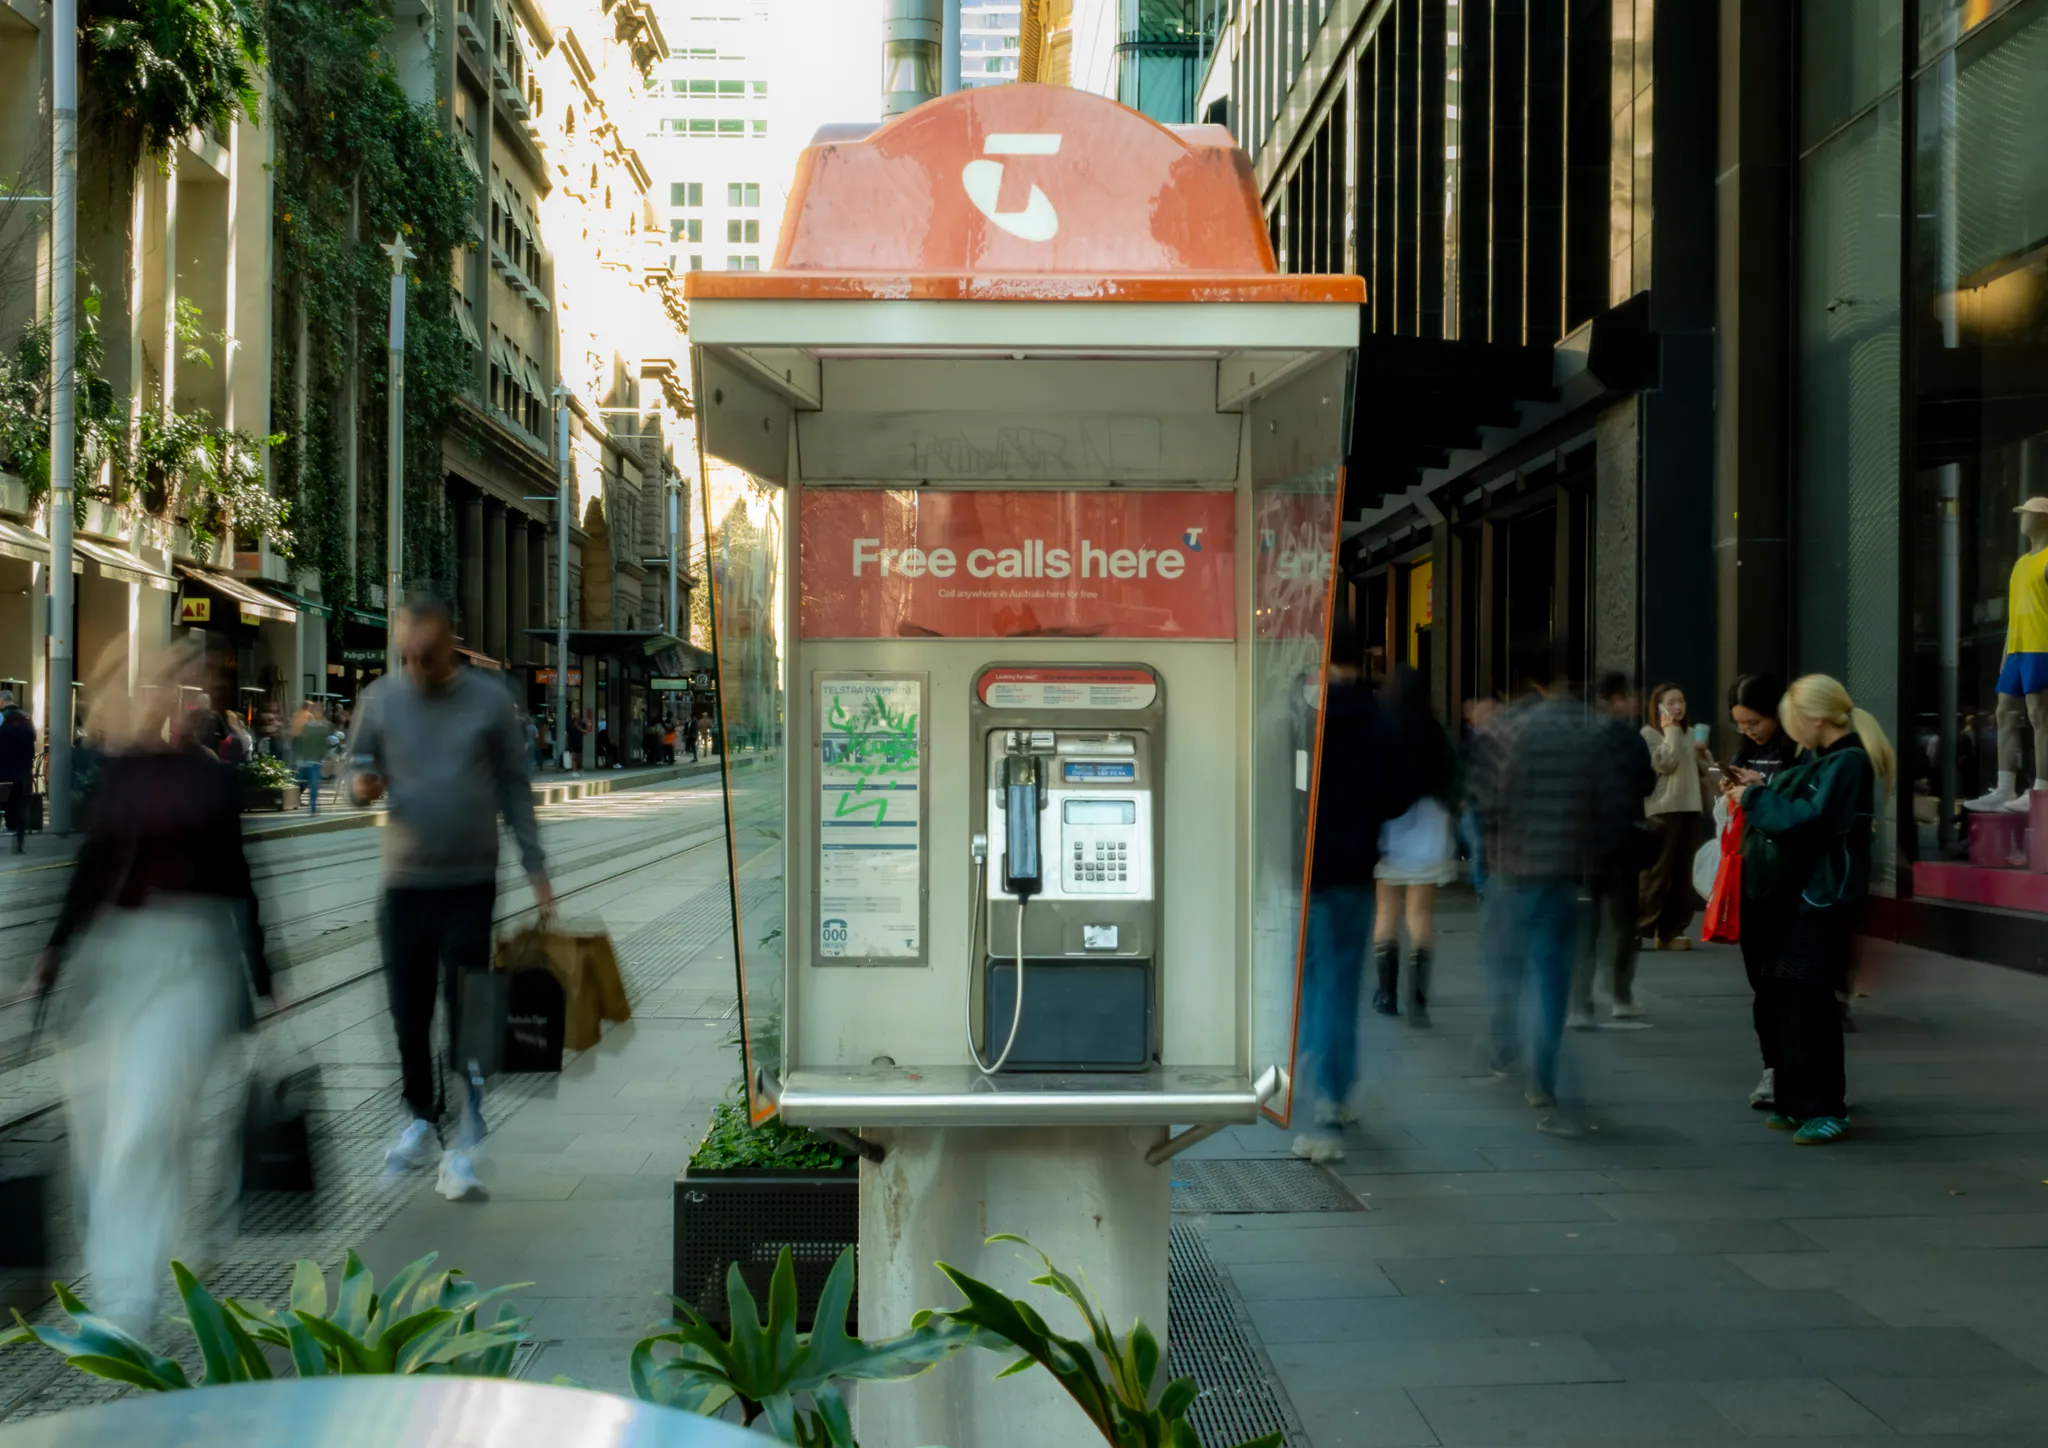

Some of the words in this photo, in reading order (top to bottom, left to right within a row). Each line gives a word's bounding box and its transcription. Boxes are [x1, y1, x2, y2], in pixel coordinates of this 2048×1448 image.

[852, 538, 956, 578] Free
[966, 538, 1071, 579] calls
[1082, 538, 1185, 579] here
[938, 588, 956, 598] Call
[957, 588, 998, 599] anywhere
[999, 588, 1008, 598] in
[1009, 588, 1045, 599] Australia
[1047, 589, 1066, 599] here
[1067, 589, 1079, 599] for
[1080, 589, 1098, 599] free
[344, 651, 366, 661] Palings
[367, 651, 376, 660] Ln
[823, 686, 863, 695] TELSTRA
[824, 746, 830, 760] 1
[823, 929, 847, 941] 000
